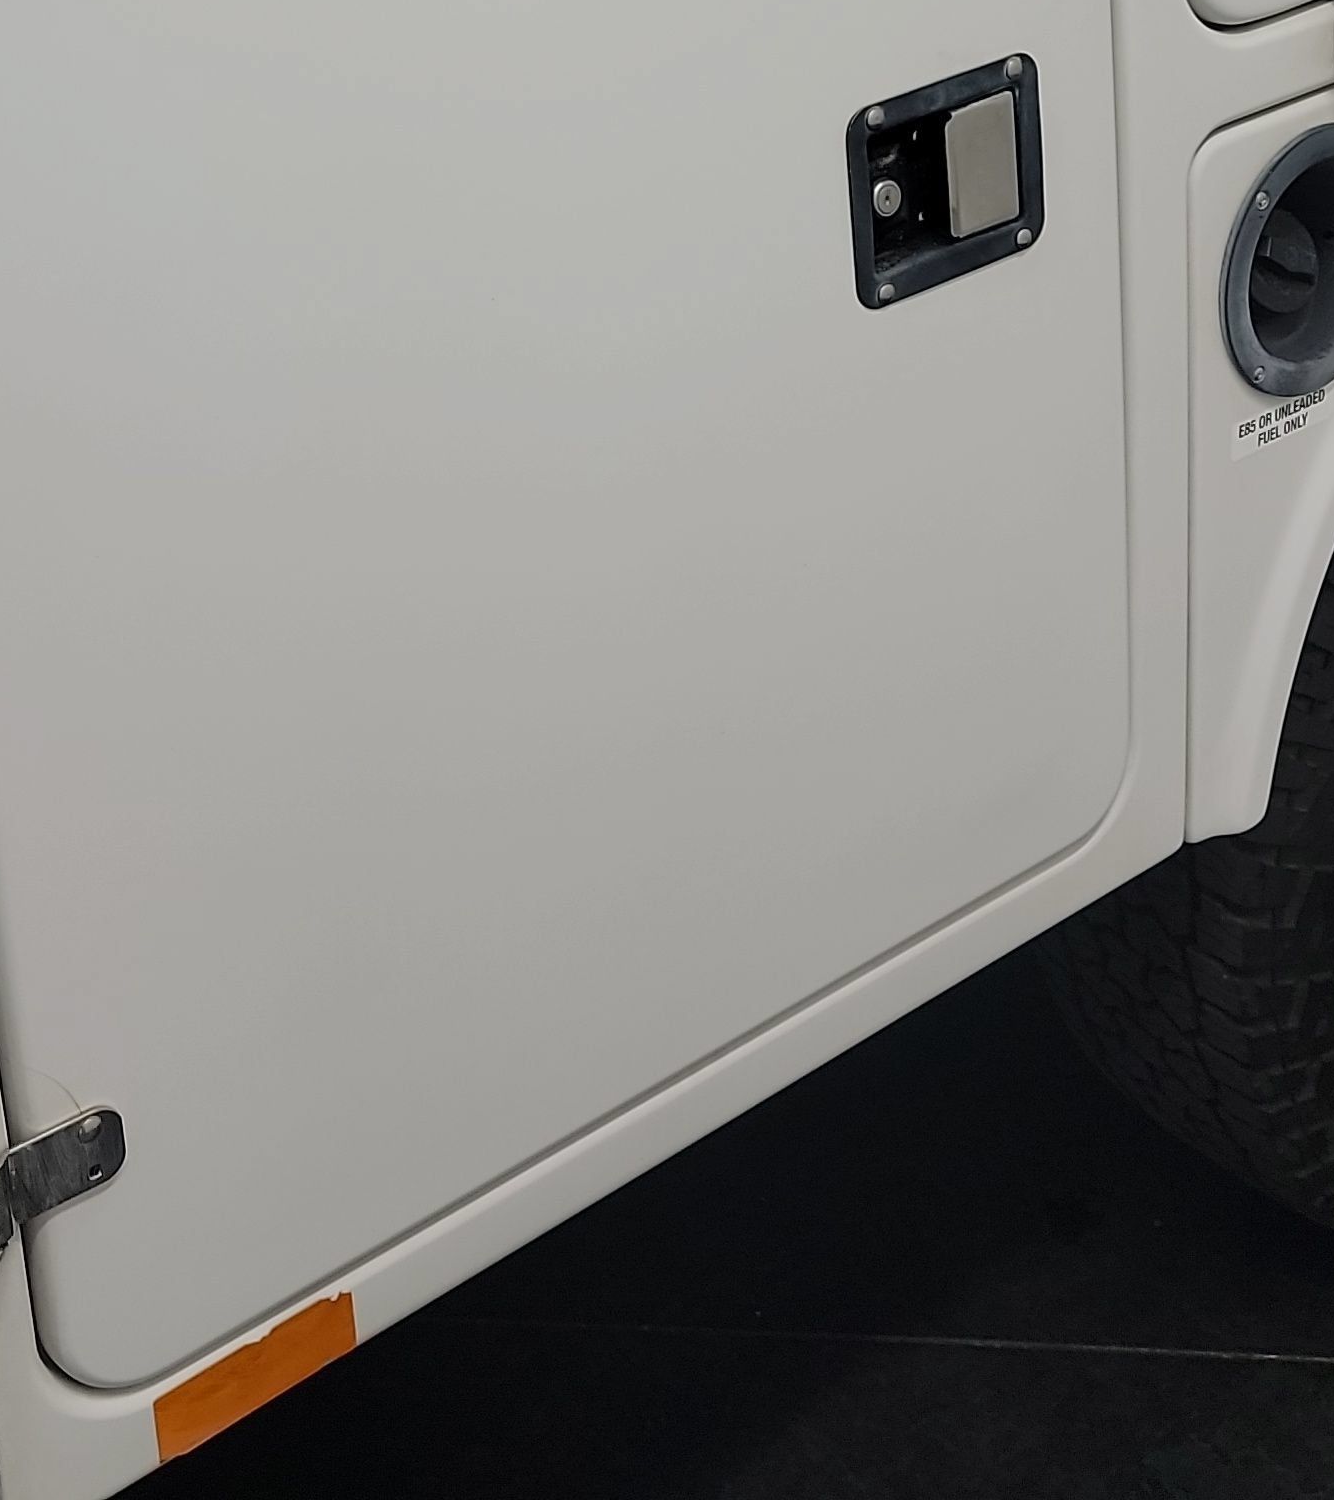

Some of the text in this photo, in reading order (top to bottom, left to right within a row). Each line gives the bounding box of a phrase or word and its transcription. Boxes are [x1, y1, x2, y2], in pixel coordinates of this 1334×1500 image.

[1238, 389, 1326, 438] E85 OR UNLEADED
[1258, 412, 1308, 447] FUEL ONLY
